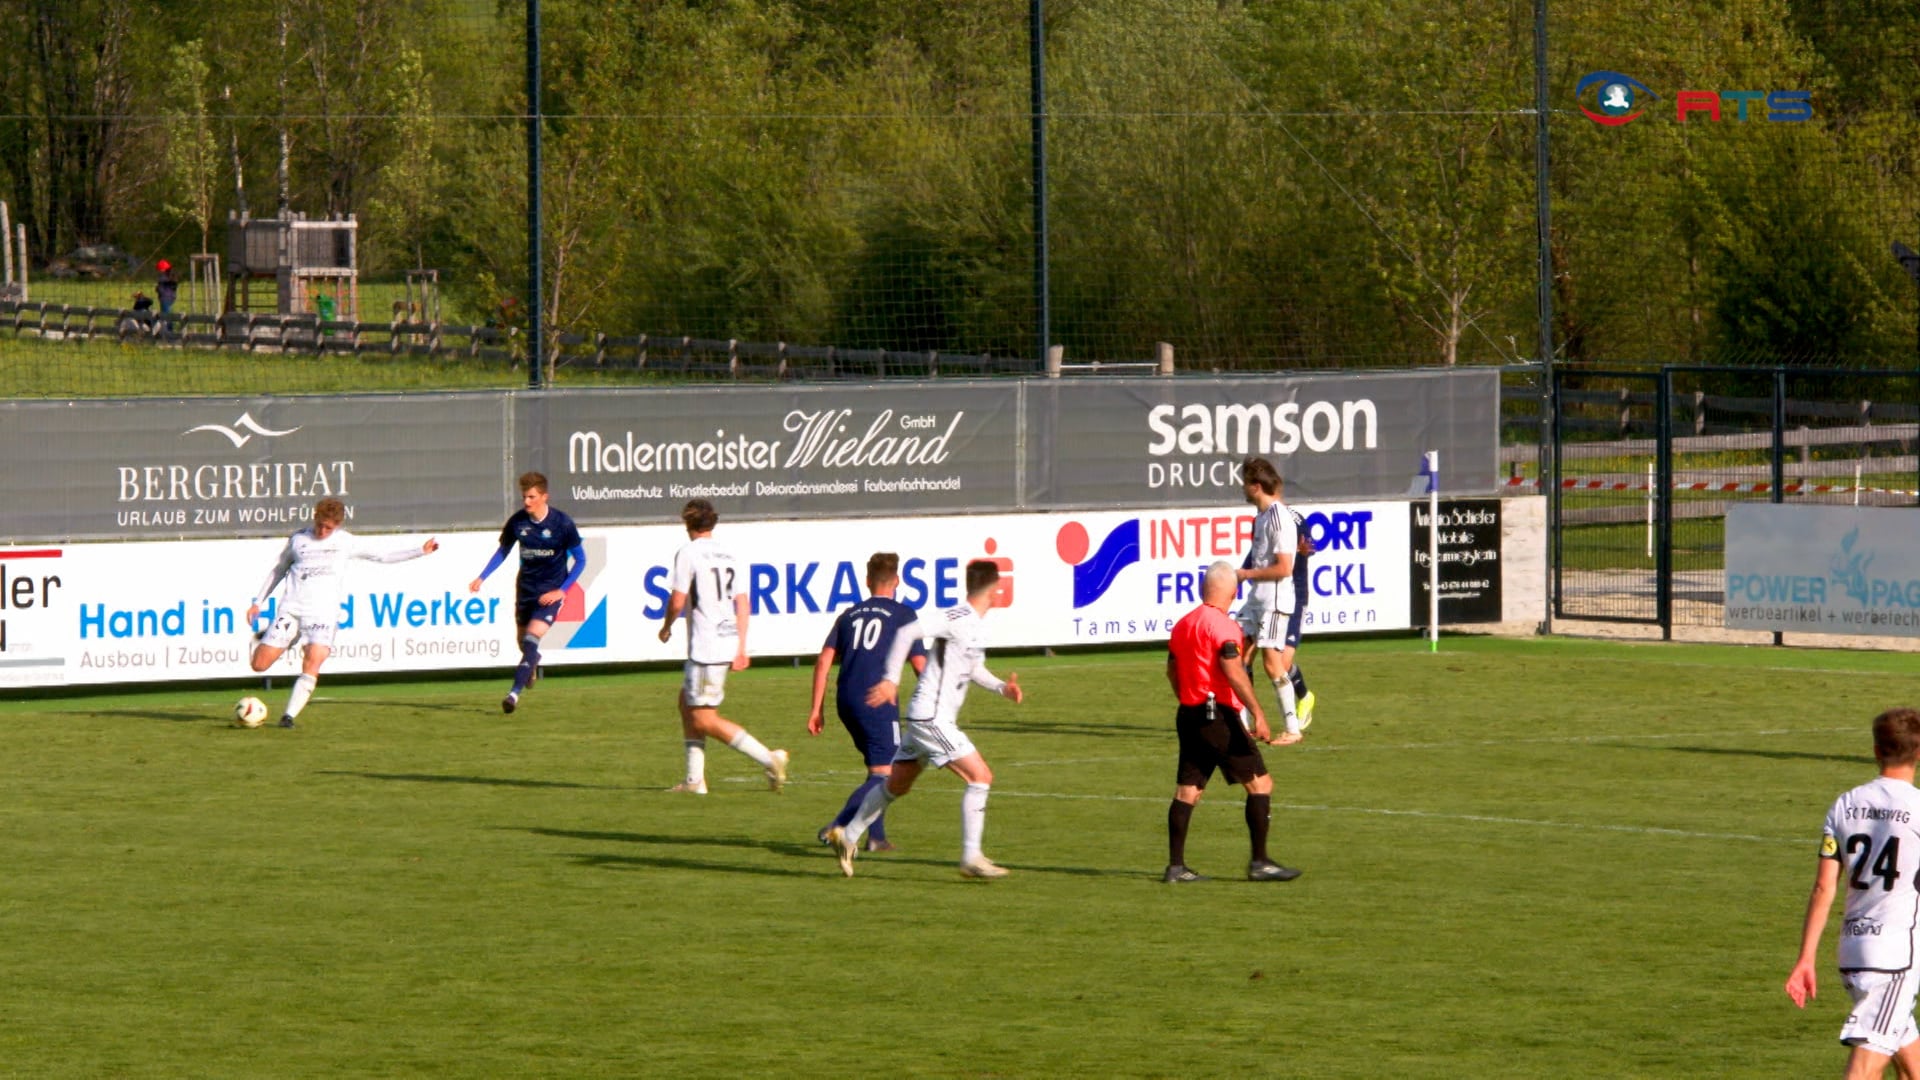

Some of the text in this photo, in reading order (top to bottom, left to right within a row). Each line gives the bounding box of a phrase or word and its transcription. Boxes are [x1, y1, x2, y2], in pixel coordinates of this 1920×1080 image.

[900, 415, 936, 429] GmbH
[1148, 398, 1378, 456] samson
[569, 408, 964, 474] Malermeister Wieland
[117, 460, 354, 502] BERGREIF.AT
[572, 485, 663, 500] Vollwärmeschutz
[669, 481, 750, 498] Künstlerbedarf
[755, 479, 858, 496] Dekorationsmalerei
[1148, 461, 1244, 488] DRUCK
[117, 504, 354, 527] URLAUB ZUM WOHLFÜN
[1150, 510, 1373, 560] INTERORT
[643, 556, 959, 621] SRKASE
[1727, 573, 1827, 604] POWER
[79, 590, 500, 640] Hand in Hd Werker
[1073, 617, 1173, 637] Tamswe
[1728, 604, 1822, 623] werbeartikel
[852, 617, 883, 651] 10
[80, 650, 156, 669] Ausbau
[178, 646, 240, 665] Zubau
[405, 636, 500, 658] Sanierung
[1861, 806, 1911, 824] TAMSWEG
[1846, 832, 1901, 892] 24
